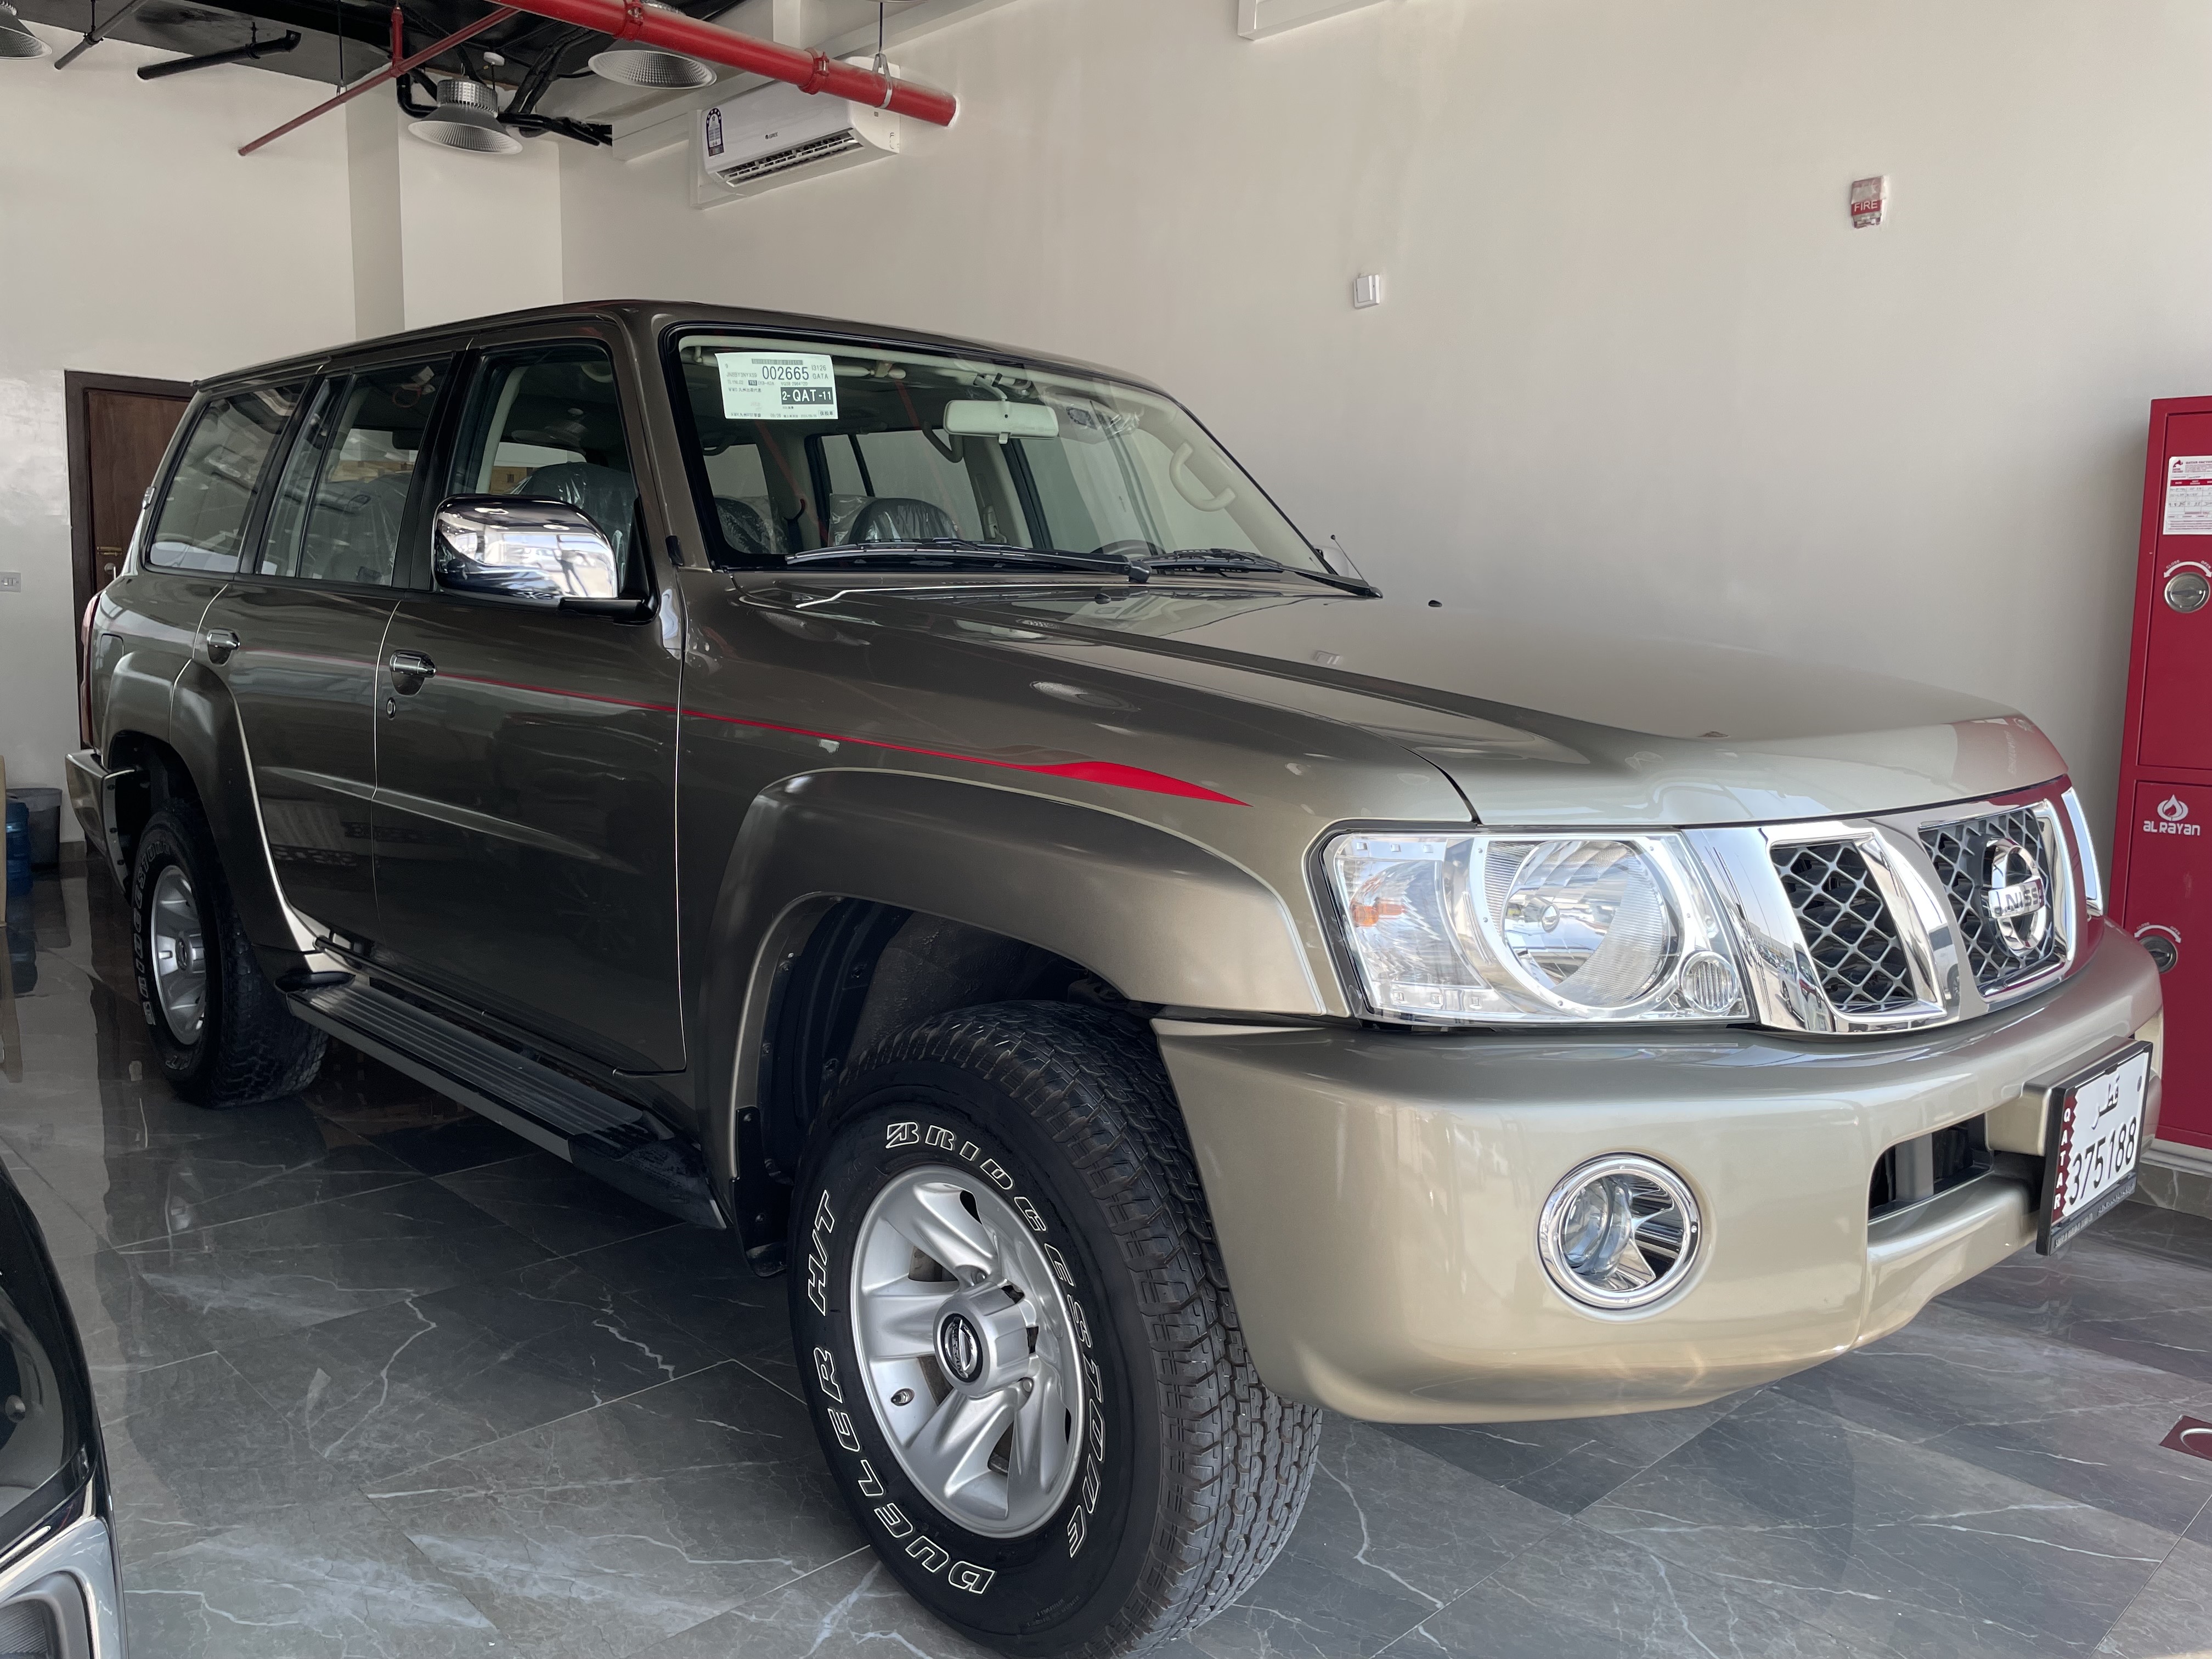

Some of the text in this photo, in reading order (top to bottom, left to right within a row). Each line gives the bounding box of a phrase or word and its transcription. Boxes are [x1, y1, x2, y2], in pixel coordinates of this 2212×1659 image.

[1854, 200, 1878, 212] FIRE
[762, 366, 809, 380] 002665
[2200, 560, 2211, 569] OPEN
[2089, 1073, 2120, 1130] قطر
[2068, 1115, 2137, 1206] 375188
[885, 1121, 1105, 1558] BRIDGESTONE
[807, 1189, 996, 1595] DUELER H/T
